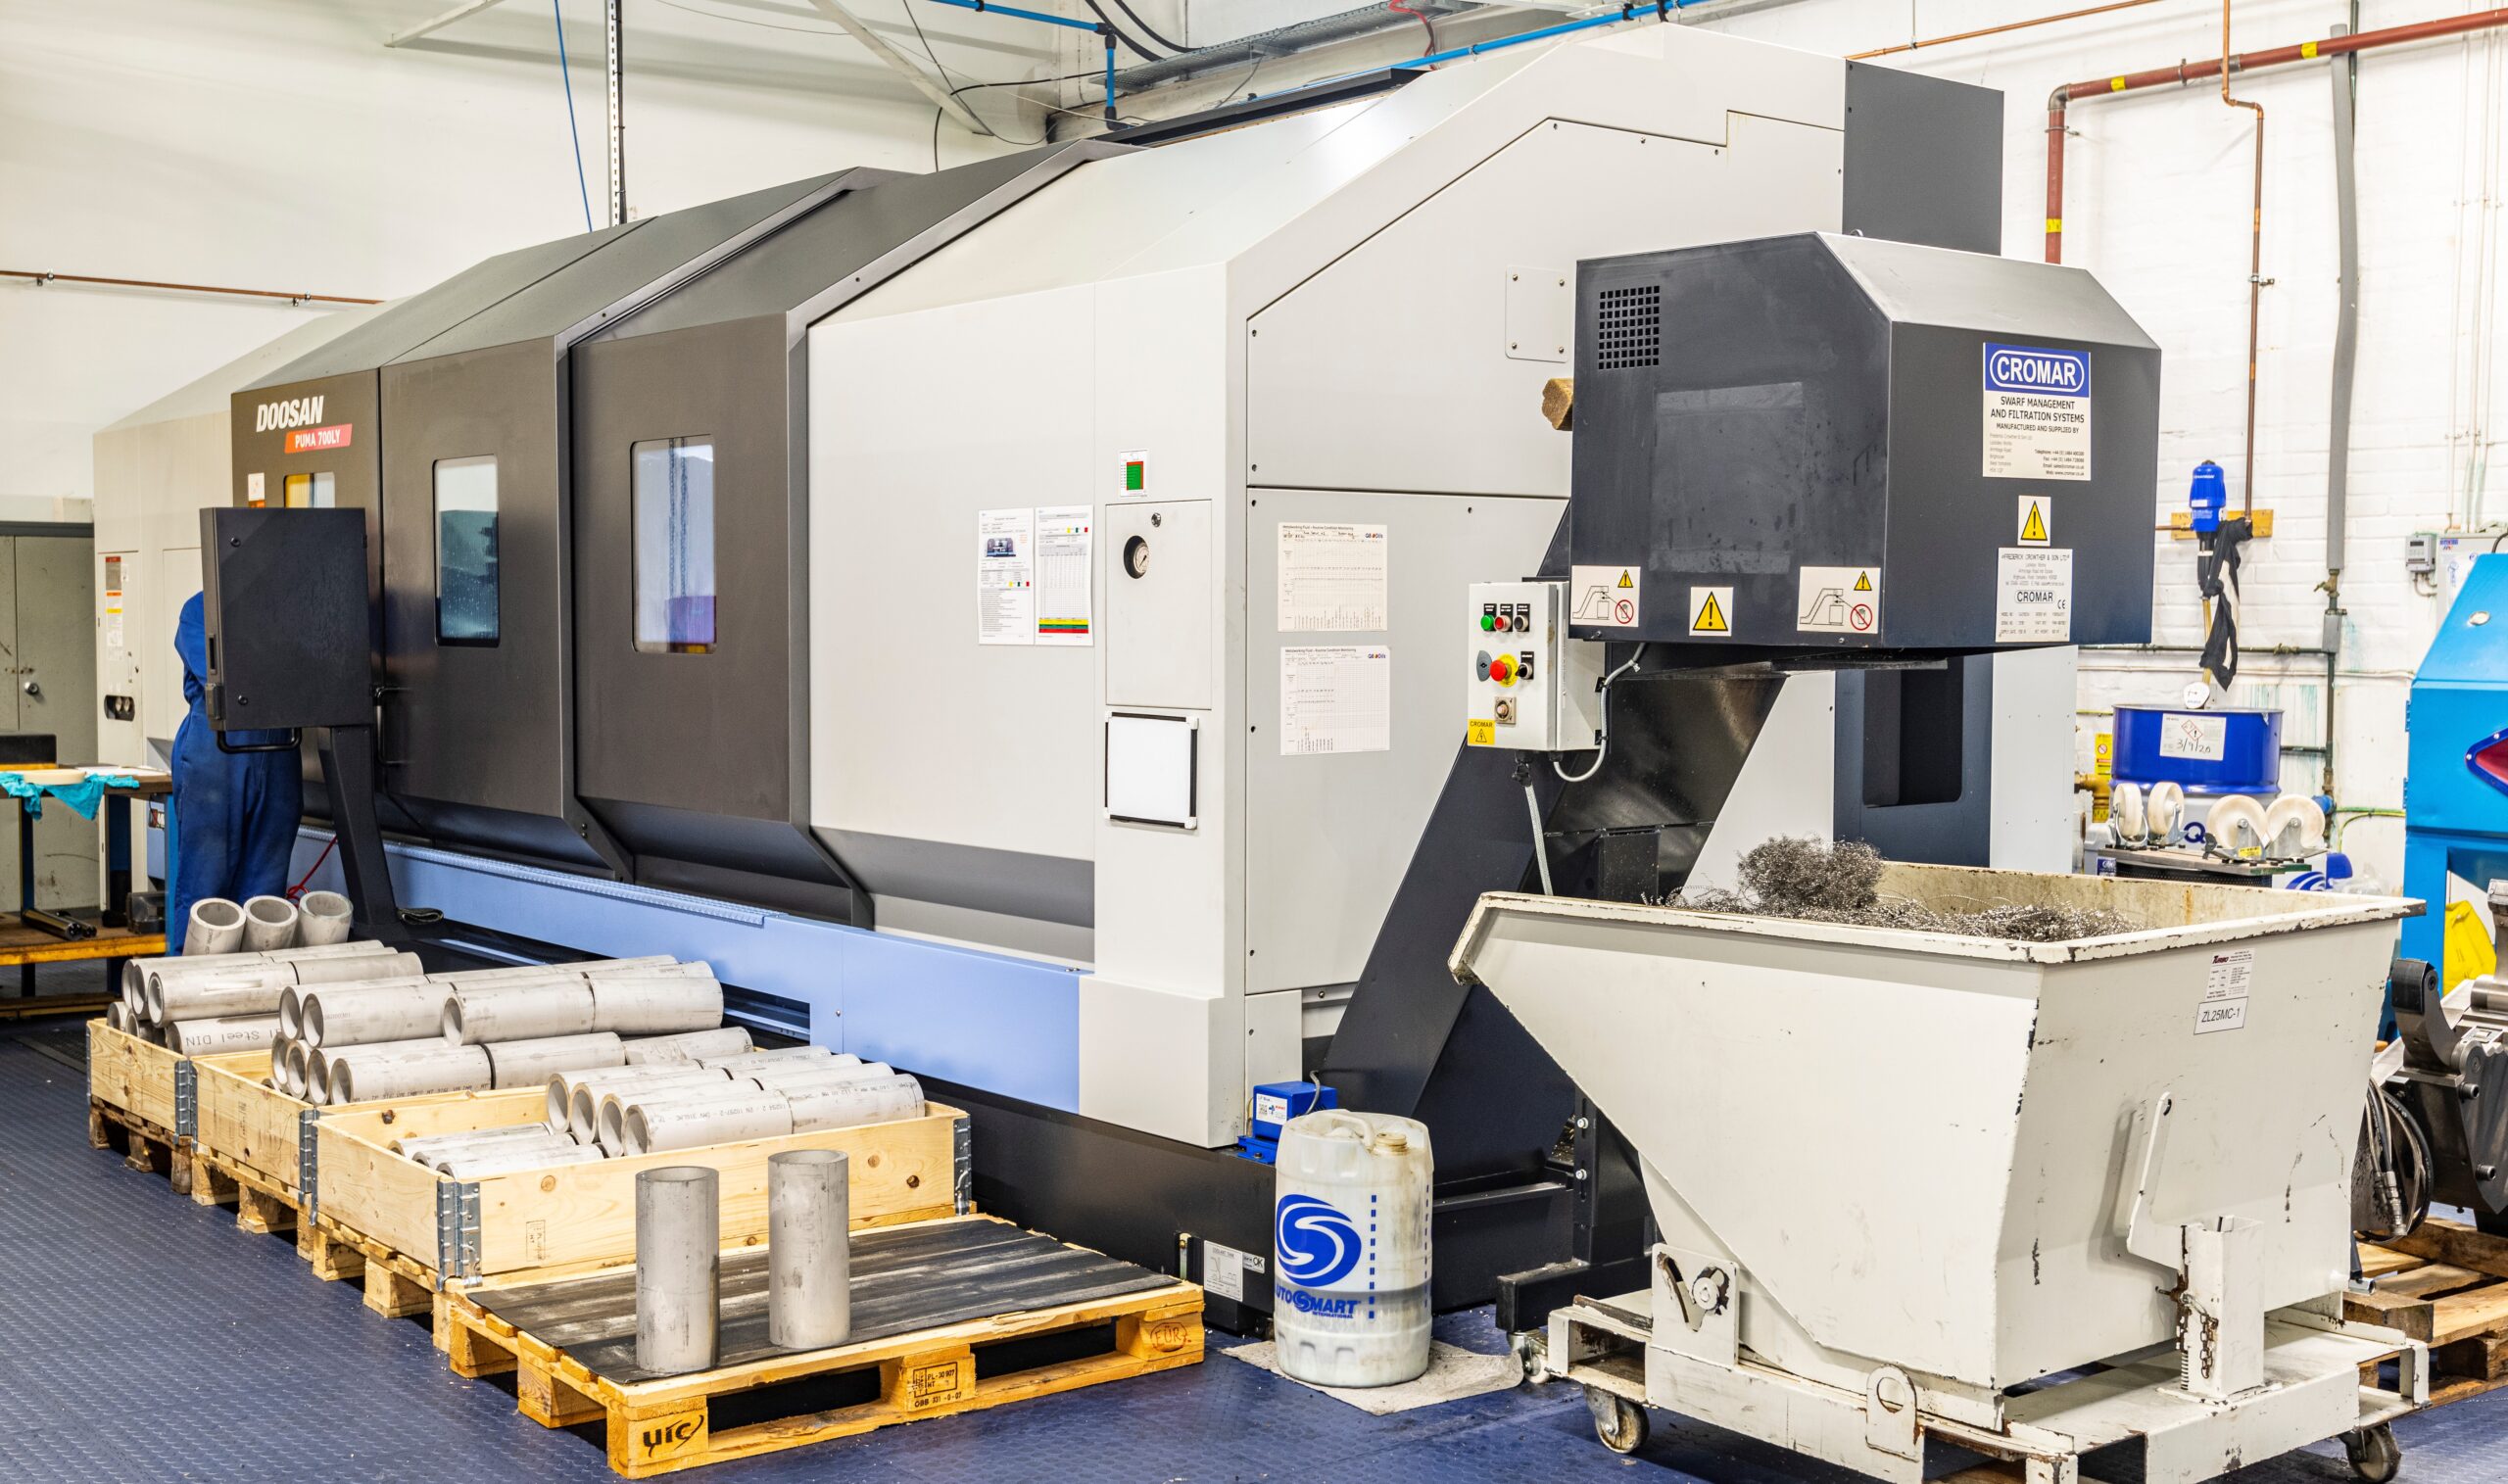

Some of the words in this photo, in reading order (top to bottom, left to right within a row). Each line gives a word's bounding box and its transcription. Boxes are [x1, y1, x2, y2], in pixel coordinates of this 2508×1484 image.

[1998, 357, 2076, 386] CROMAR
[2001, 396, 2026, 407] SWARF
[2027, 399, 2075, 409] MANAGEMENT
[256, 396, 324, 432] DOOSAN
[1991, 408, 2006, 418] AND
[2008, 409, 2051, 421] FILTRATION
[2052, 413, 2085, 423] SYSTEMS
[1997, 423, 2036, 432] MANUFACTURED
[295, 433, 315, 449] PUMA
[318, 429, 341, 445] 700LY
[2016, 591, 2053, 602] CROMAR
[2200, 1007, 2241, 1023] ZL25MC-1
[185, 1034, 212, 1047] DIN
[221, 1029, 260, 1043] Steel
[1253, 1257, 1264, 1269] OK
[1276, 1284, 1358, 1314] UTOSMART
